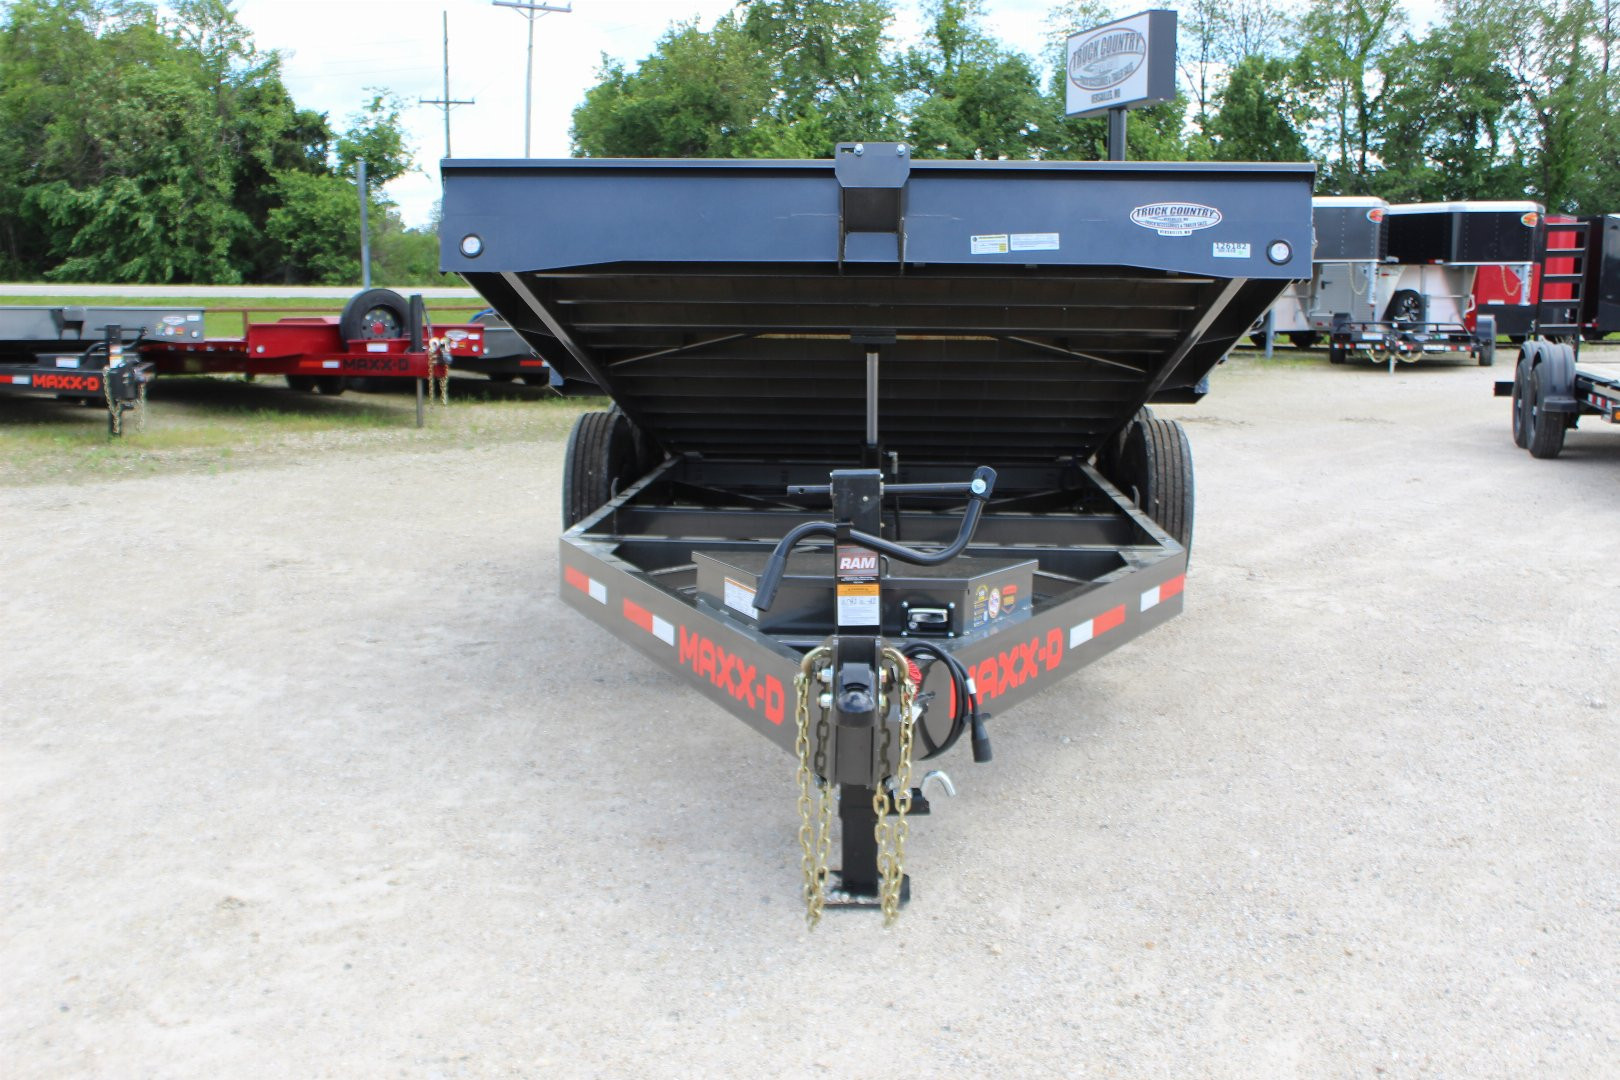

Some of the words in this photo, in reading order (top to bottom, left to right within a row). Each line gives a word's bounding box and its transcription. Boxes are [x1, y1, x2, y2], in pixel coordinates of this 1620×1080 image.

[1073, 40, 1099, 71] TRUCK
[1100, 32, 1142, 56] COUNTRY
[1136, 206, 1168, 217] TRUCK
[1170, 206, 1216, 217] COUNTRY
[1215, 242, 1247, 250] 126182
[343, 358, 410, 371] MAXX-D
[32, 373, 100, 391] MAXX-D
[840, 557, 876, 569] RAM
[679, 624, 785, 726] MAXX-D
